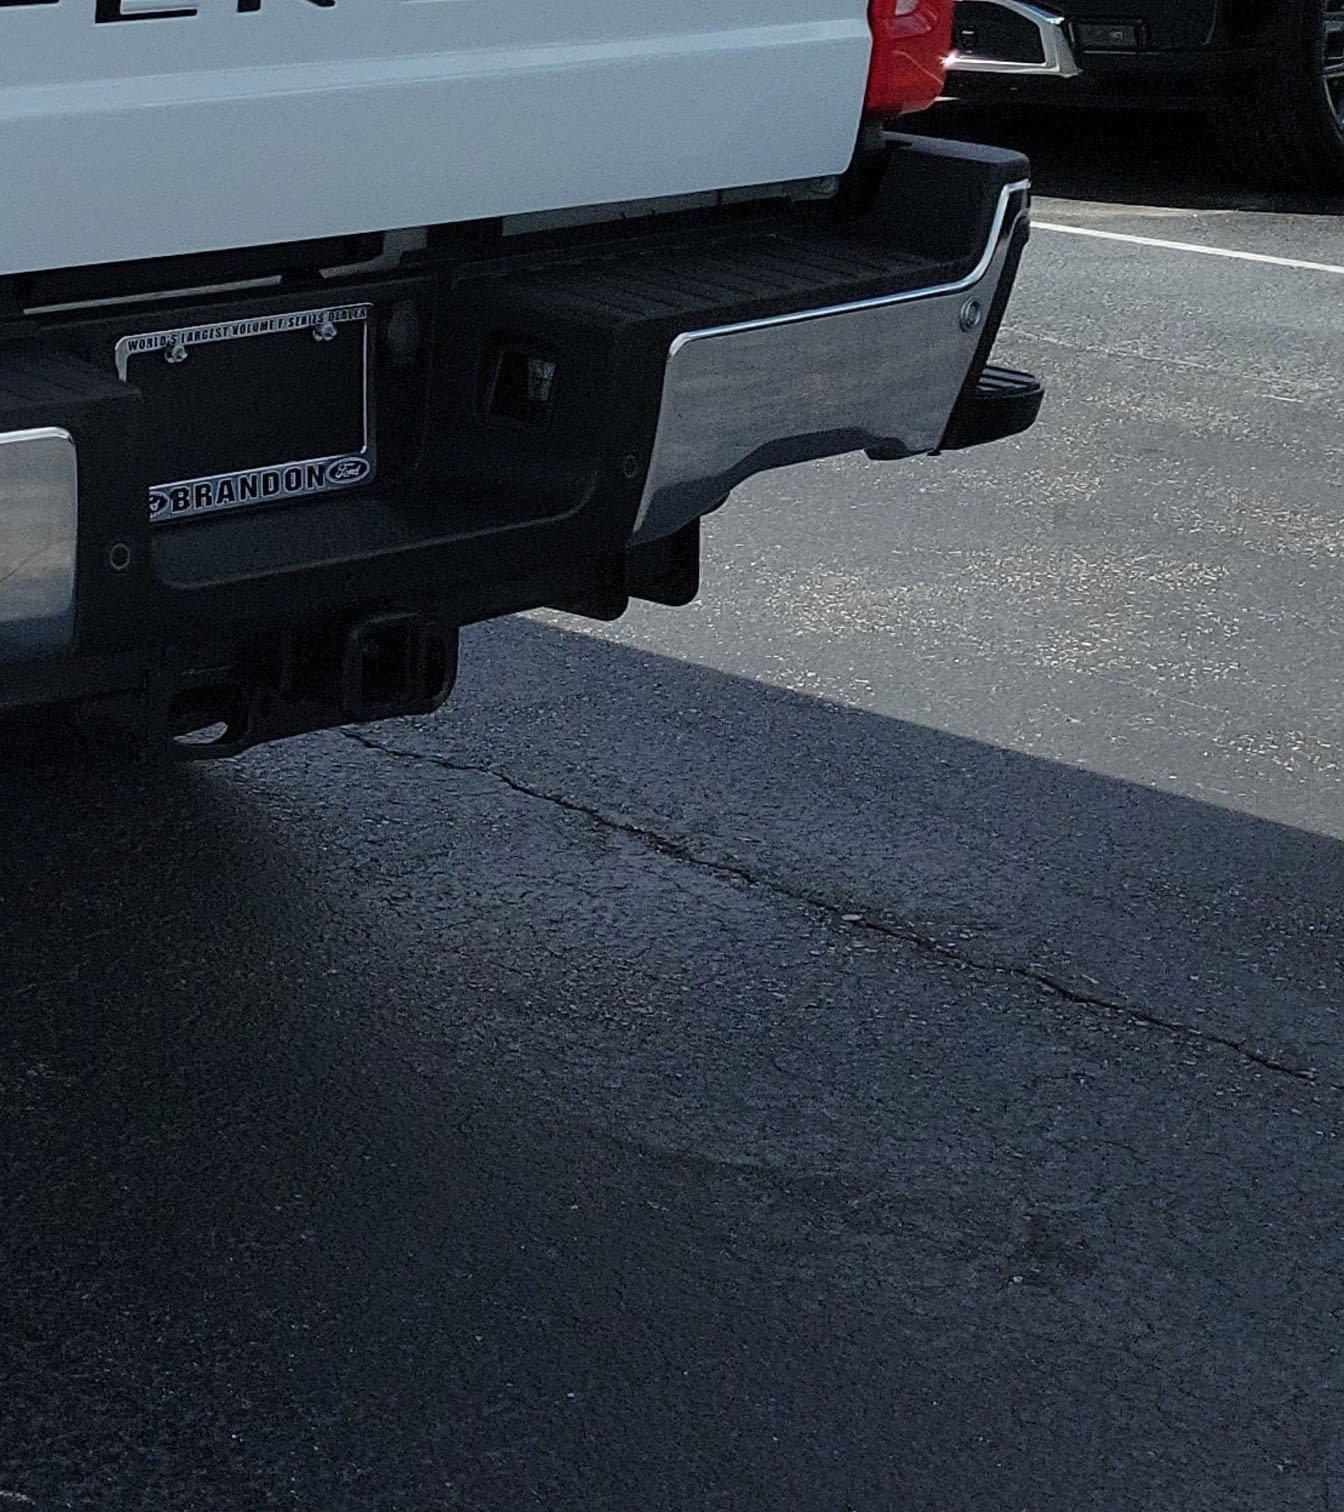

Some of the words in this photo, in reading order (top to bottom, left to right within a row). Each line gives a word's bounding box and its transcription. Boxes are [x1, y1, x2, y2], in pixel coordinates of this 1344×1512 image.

[181, 327, 228, 344] LARGEST
[232, 319, 276, 336] VOLUME
[170, 463, 325, 513] BRANDON
